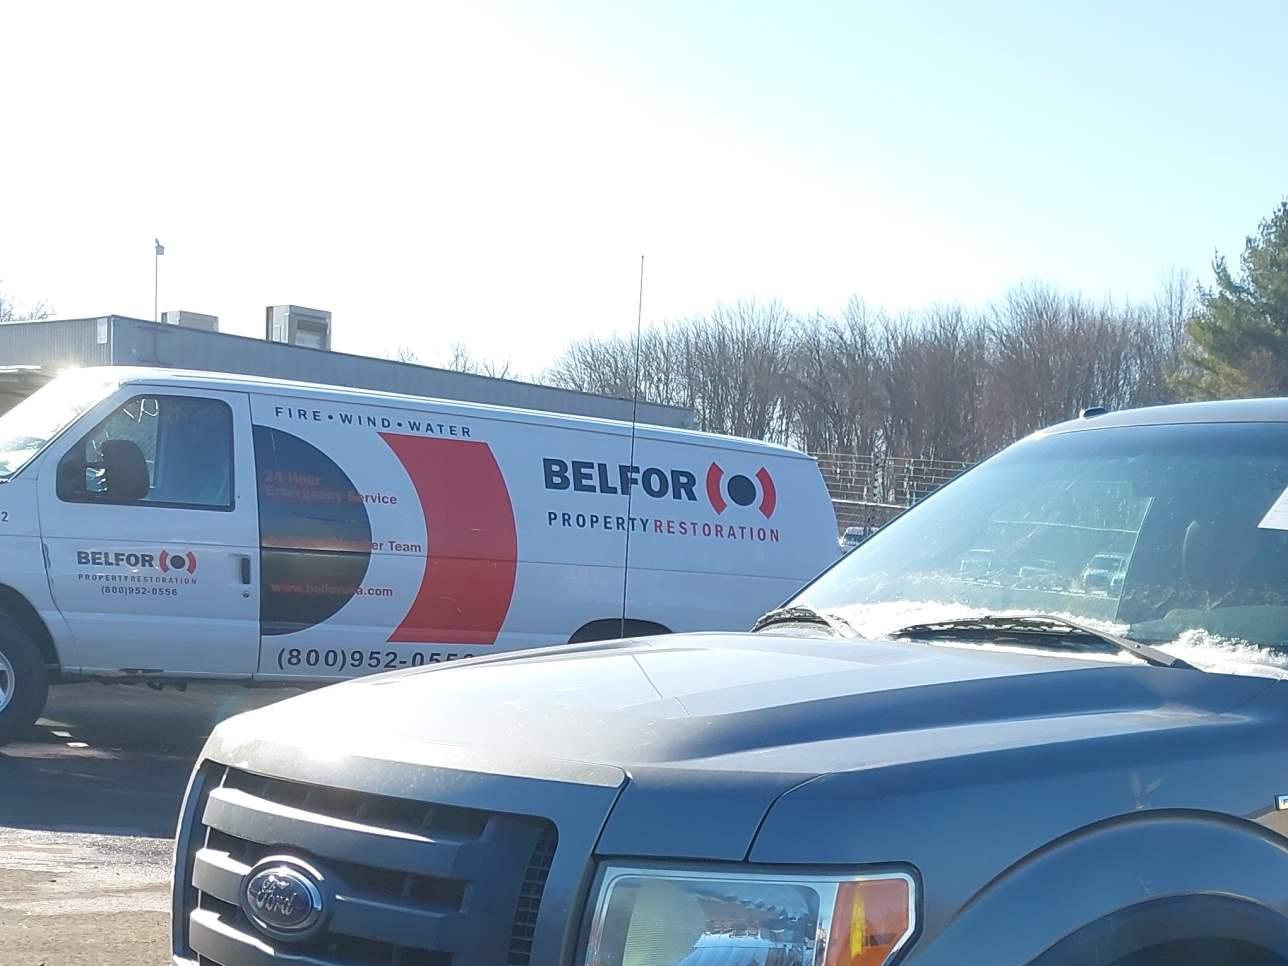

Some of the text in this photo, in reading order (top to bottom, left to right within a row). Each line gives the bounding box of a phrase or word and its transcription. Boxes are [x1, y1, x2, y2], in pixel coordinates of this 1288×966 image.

[275, 406, 472, 438] FIRE WIND WATER
[543, 458, 697, 501] BELFOR
[388, 540, 422, 553] Team
[76, 551, 155, 568] BELFOR
[101, 585, 178, 597] (800)952-0556
[277, 649, 474, 672] (800)952-05
